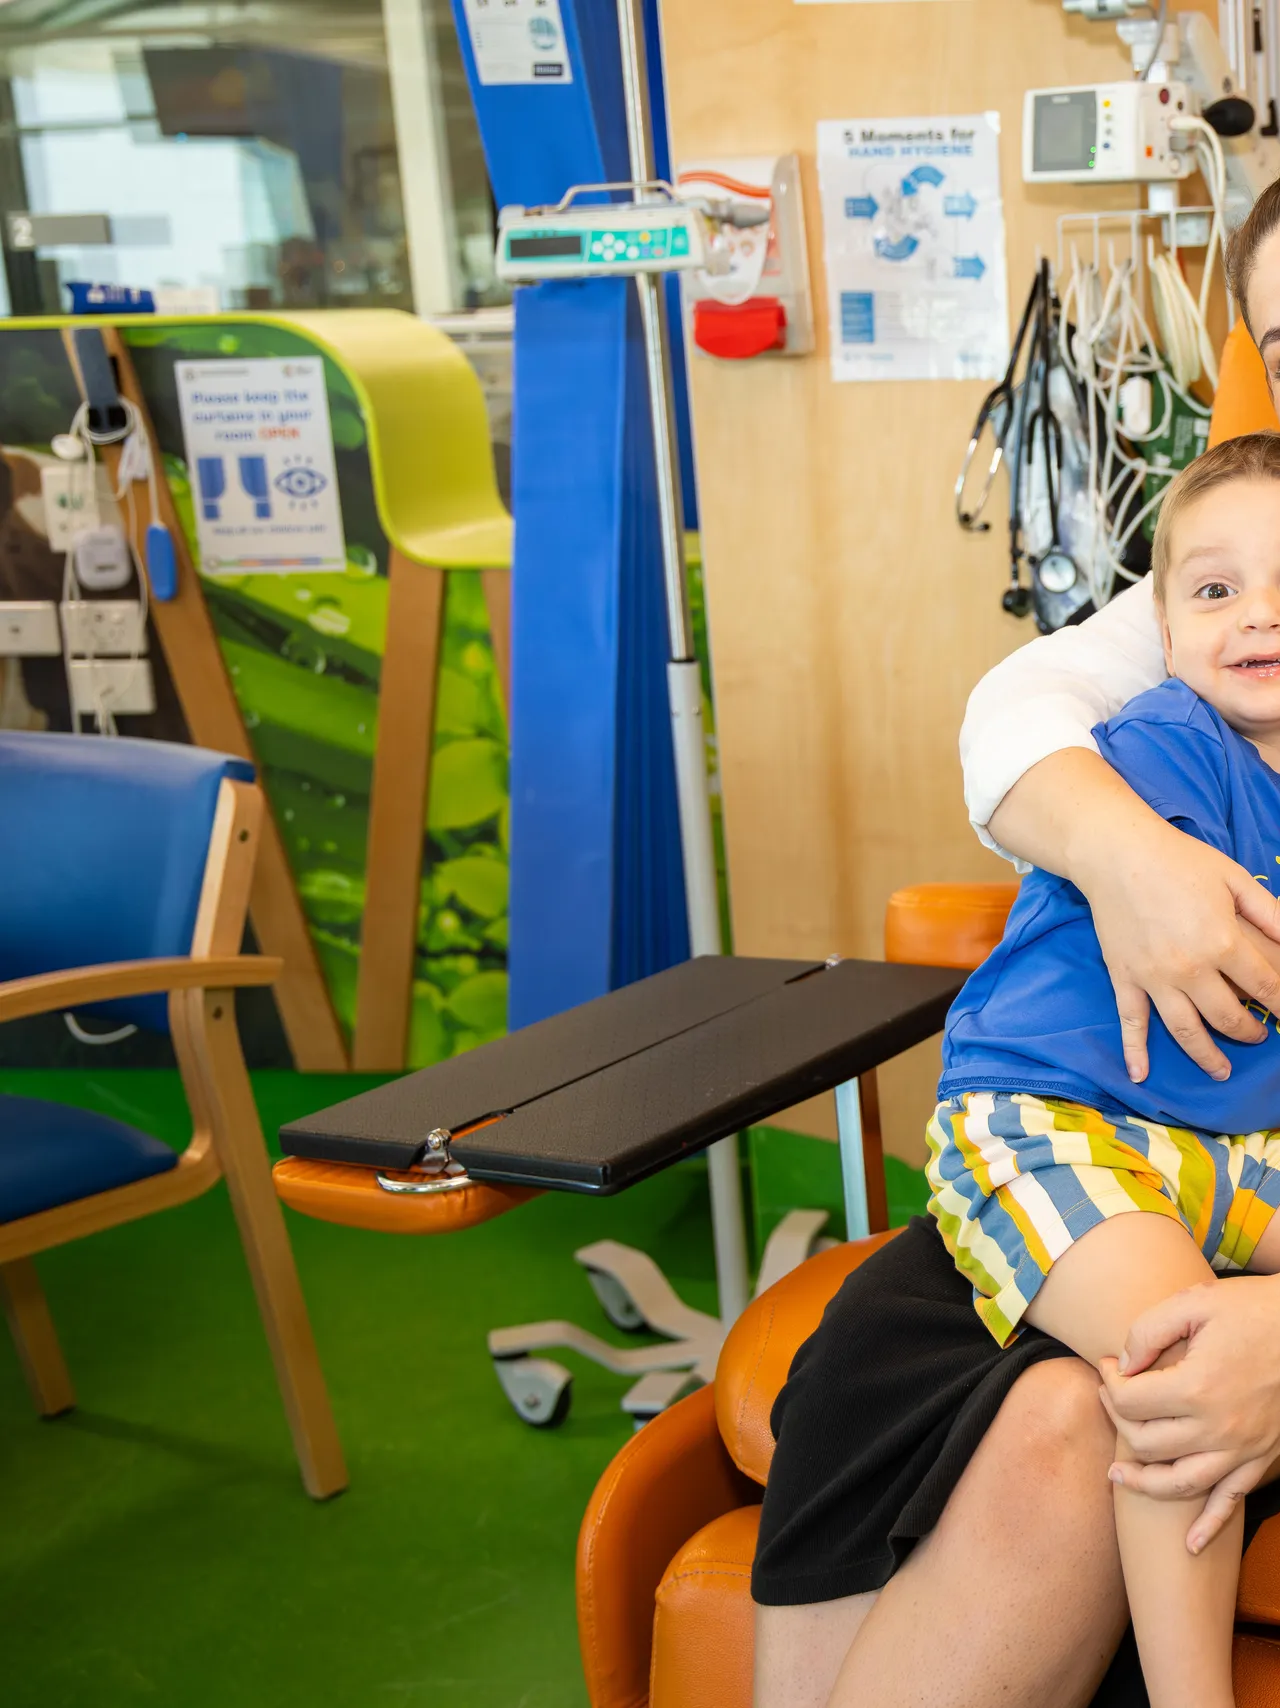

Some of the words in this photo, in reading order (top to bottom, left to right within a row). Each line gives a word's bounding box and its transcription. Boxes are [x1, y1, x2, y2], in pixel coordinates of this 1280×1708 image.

[861, 127, 944, 142] Moments
[951, 127, 975, 140] for
[848, 146, 895, 157] HAND
[900, 144, 974, 157] HYGIENE
[13, 217, 34, 247] 2
[191, 390, 240, 405] Please
[214, 430, 254, 441] room
[258, 427, 300, 440] OPEN
